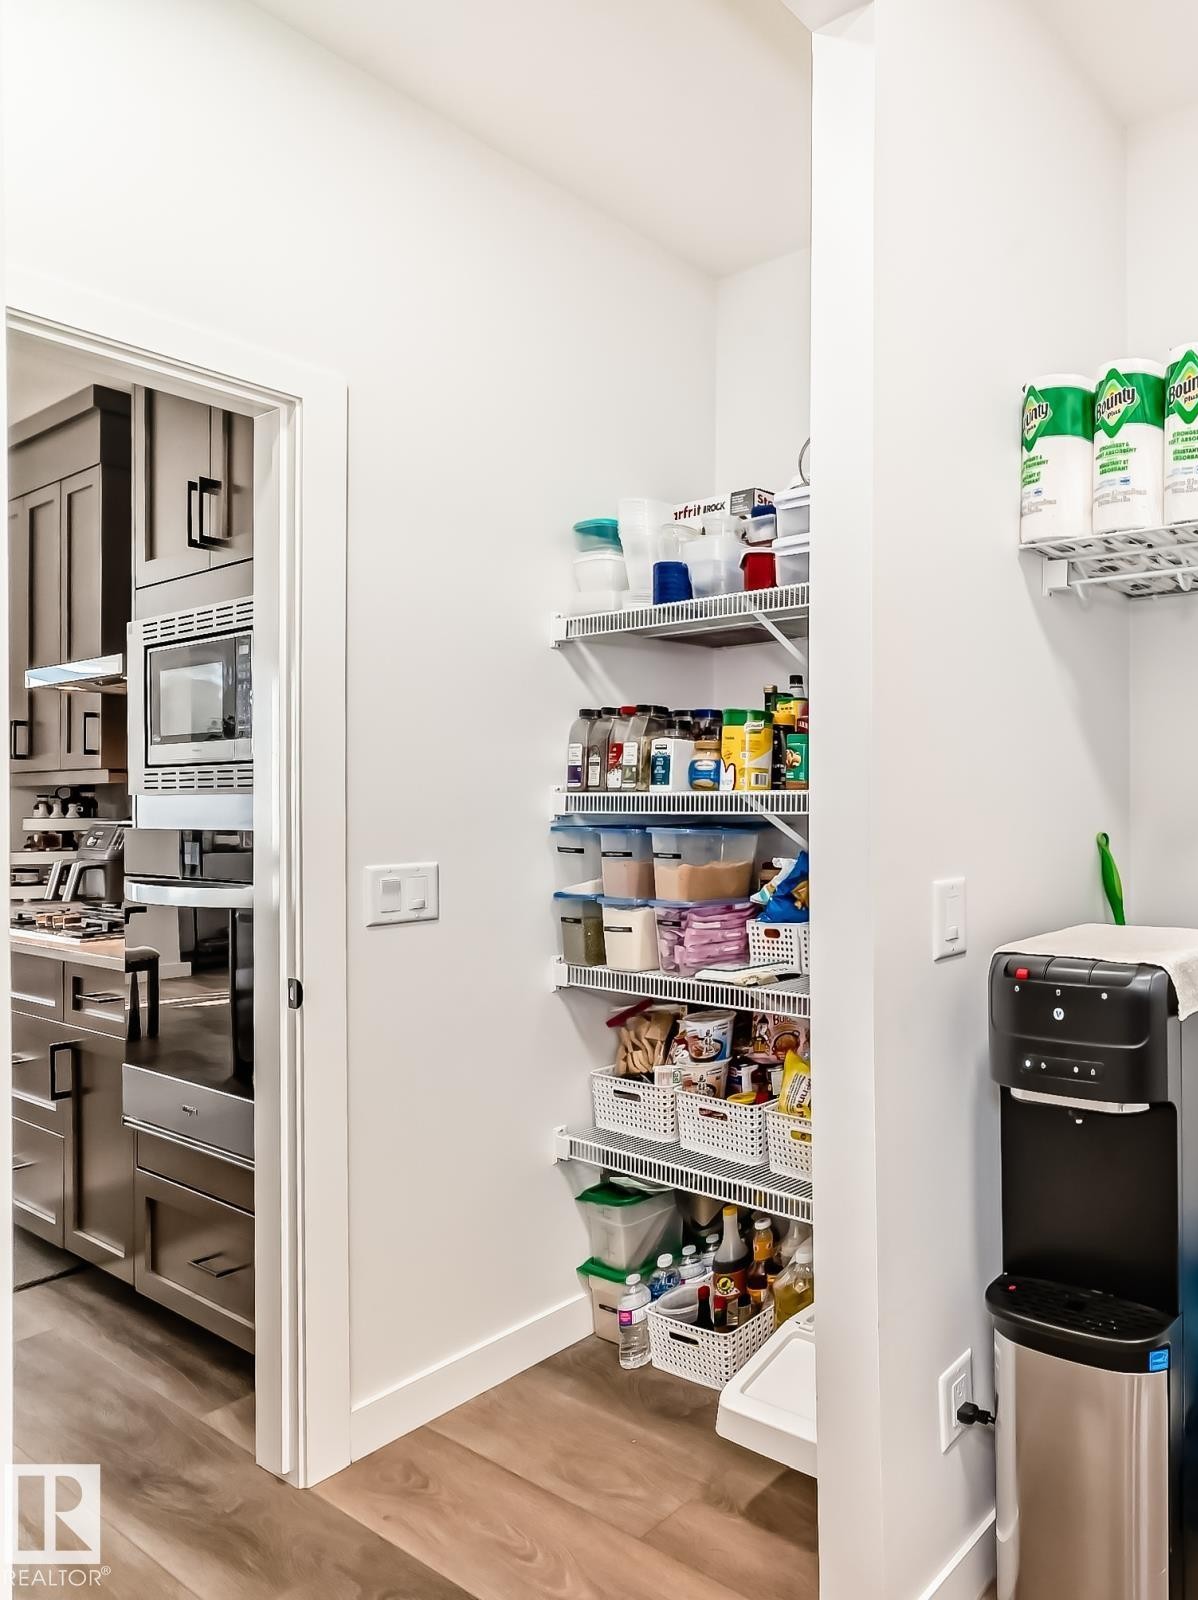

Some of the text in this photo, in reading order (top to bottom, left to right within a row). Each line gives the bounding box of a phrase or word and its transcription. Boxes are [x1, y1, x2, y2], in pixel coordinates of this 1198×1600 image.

[1096, 387, 1136, 423] Bounty
[1183, 393, 1198, 404] Plus
[1023, 402, 1049, 428] unty
